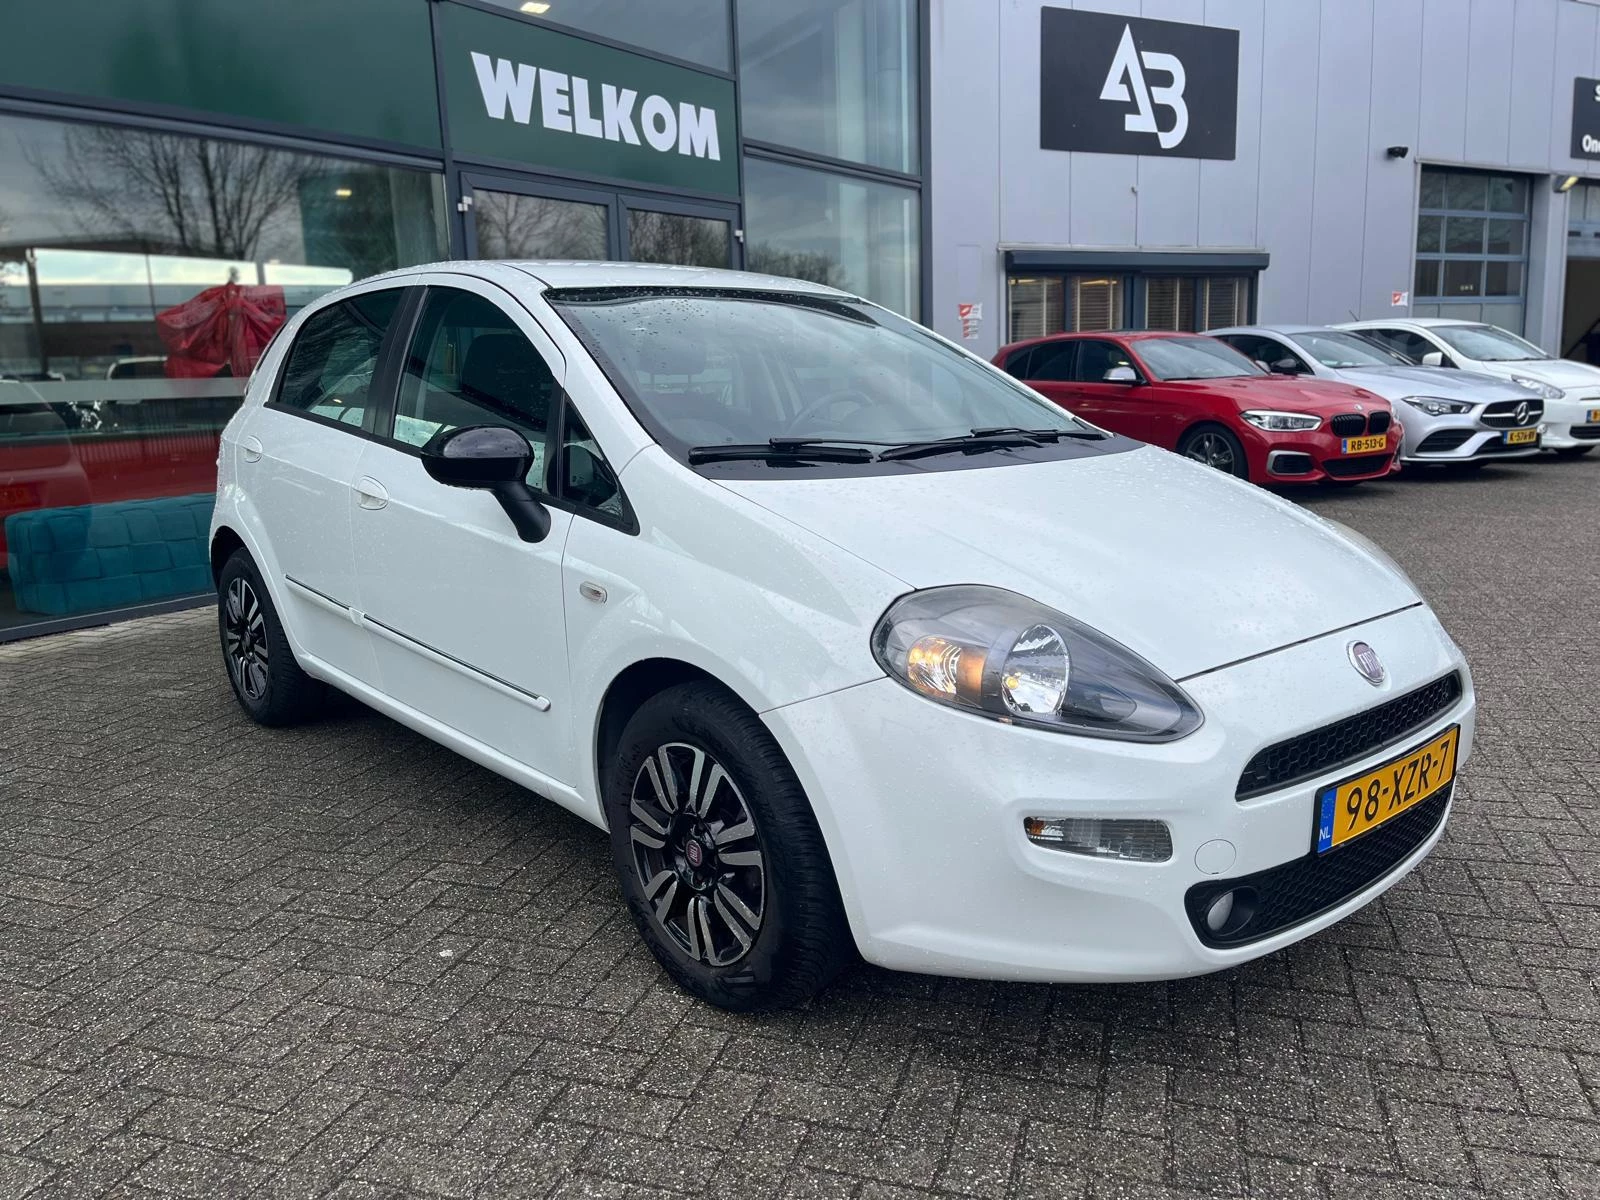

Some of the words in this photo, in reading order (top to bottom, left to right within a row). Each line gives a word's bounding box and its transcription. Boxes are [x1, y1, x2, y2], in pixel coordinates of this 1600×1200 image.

[470, 51, 721, 161] WELKOM
[1099, 23, 1189, 149] AB
[1582, 134, 1600, 153] On
[1350, 437, 1385, 452] RB-513-G
[1346, 739, 1450, 831] 98-XZR-7
[1318, 825, 1331, 841] NL
